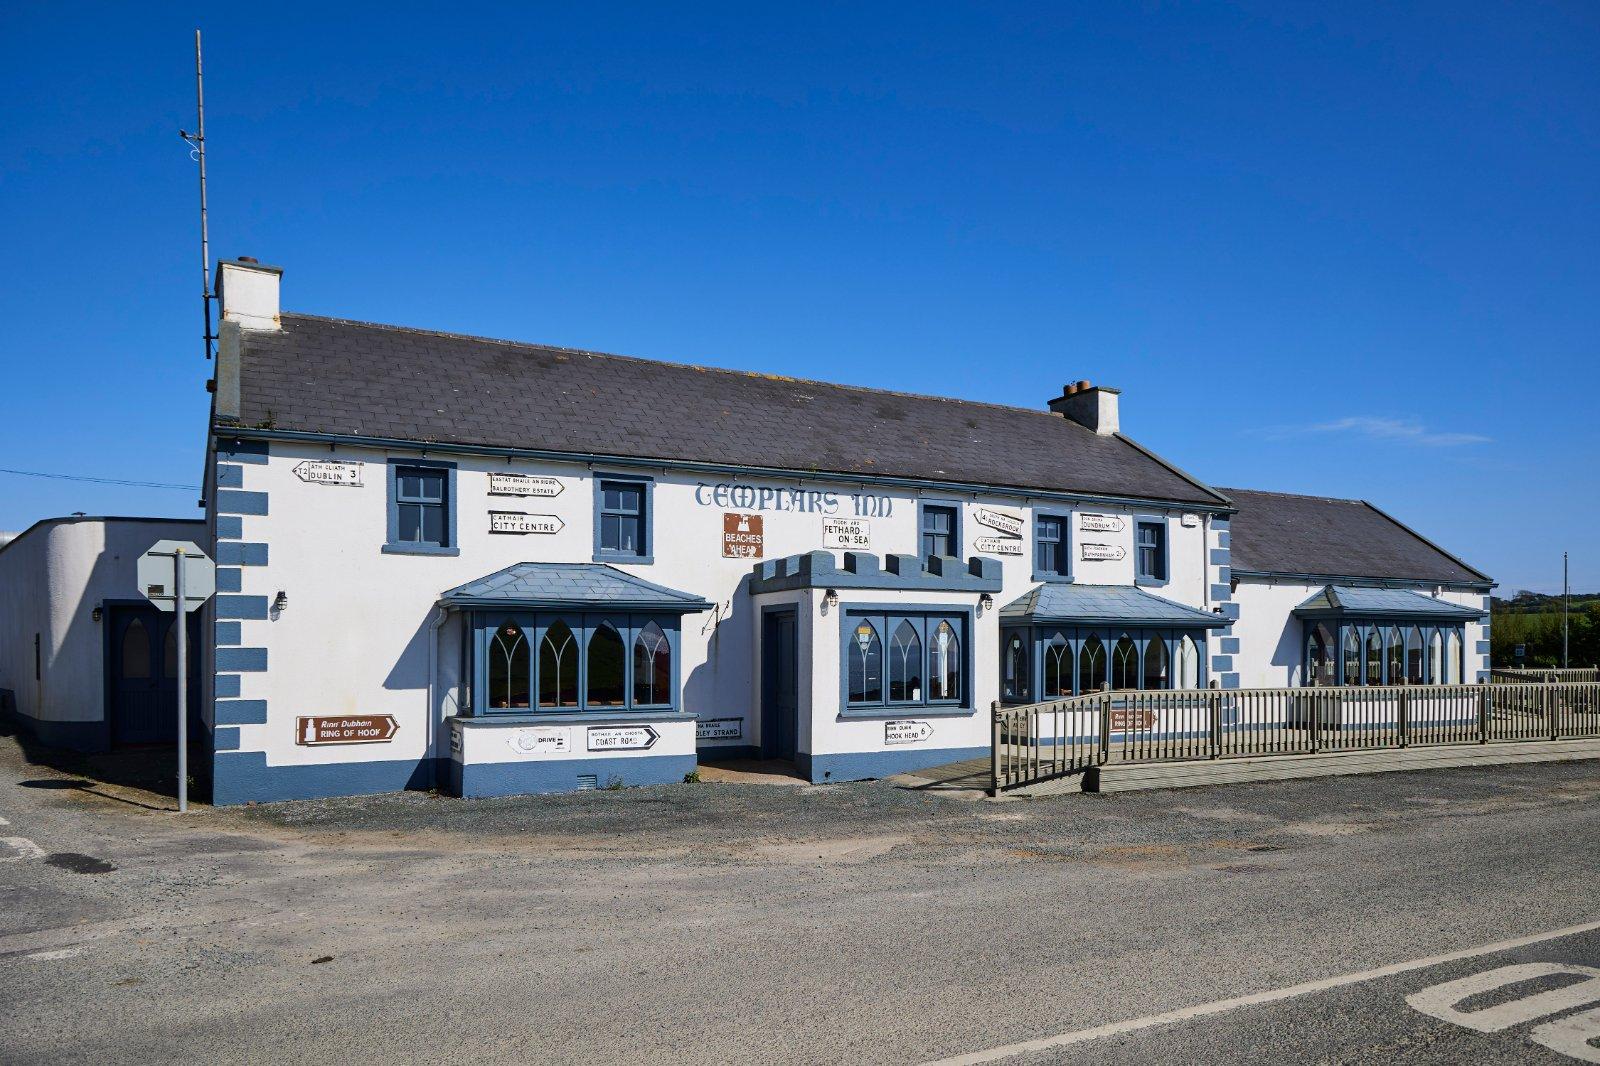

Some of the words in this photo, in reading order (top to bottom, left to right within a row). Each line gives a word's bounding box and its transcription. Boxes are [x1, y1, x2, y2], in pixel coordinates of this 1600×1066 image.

[310, 472, 343, 480] DUBLIN
[350, 470, 357, 478] 3
[695, 482, 839, 514] TEMPLARS
[519, 523, 555, 532] CENTRE
[988, 518, 1020, 532] ROCKBROOK
[725, 533, 763, 544] BEACHES
[731, 544, 757, 554] AHEAD
[997, 544, 1021, 552] CENTRE
[321, 720, 338, 728] Rinn
[340, 719, 372, 728] Dubhain
[320, 730, 340, 738] RING
[343, 729, 355, 737] OF
[357, 728, 381, 737] HOOK
[920, 727, 926, 735] 6
[595, 738, 616, 746] COAST
